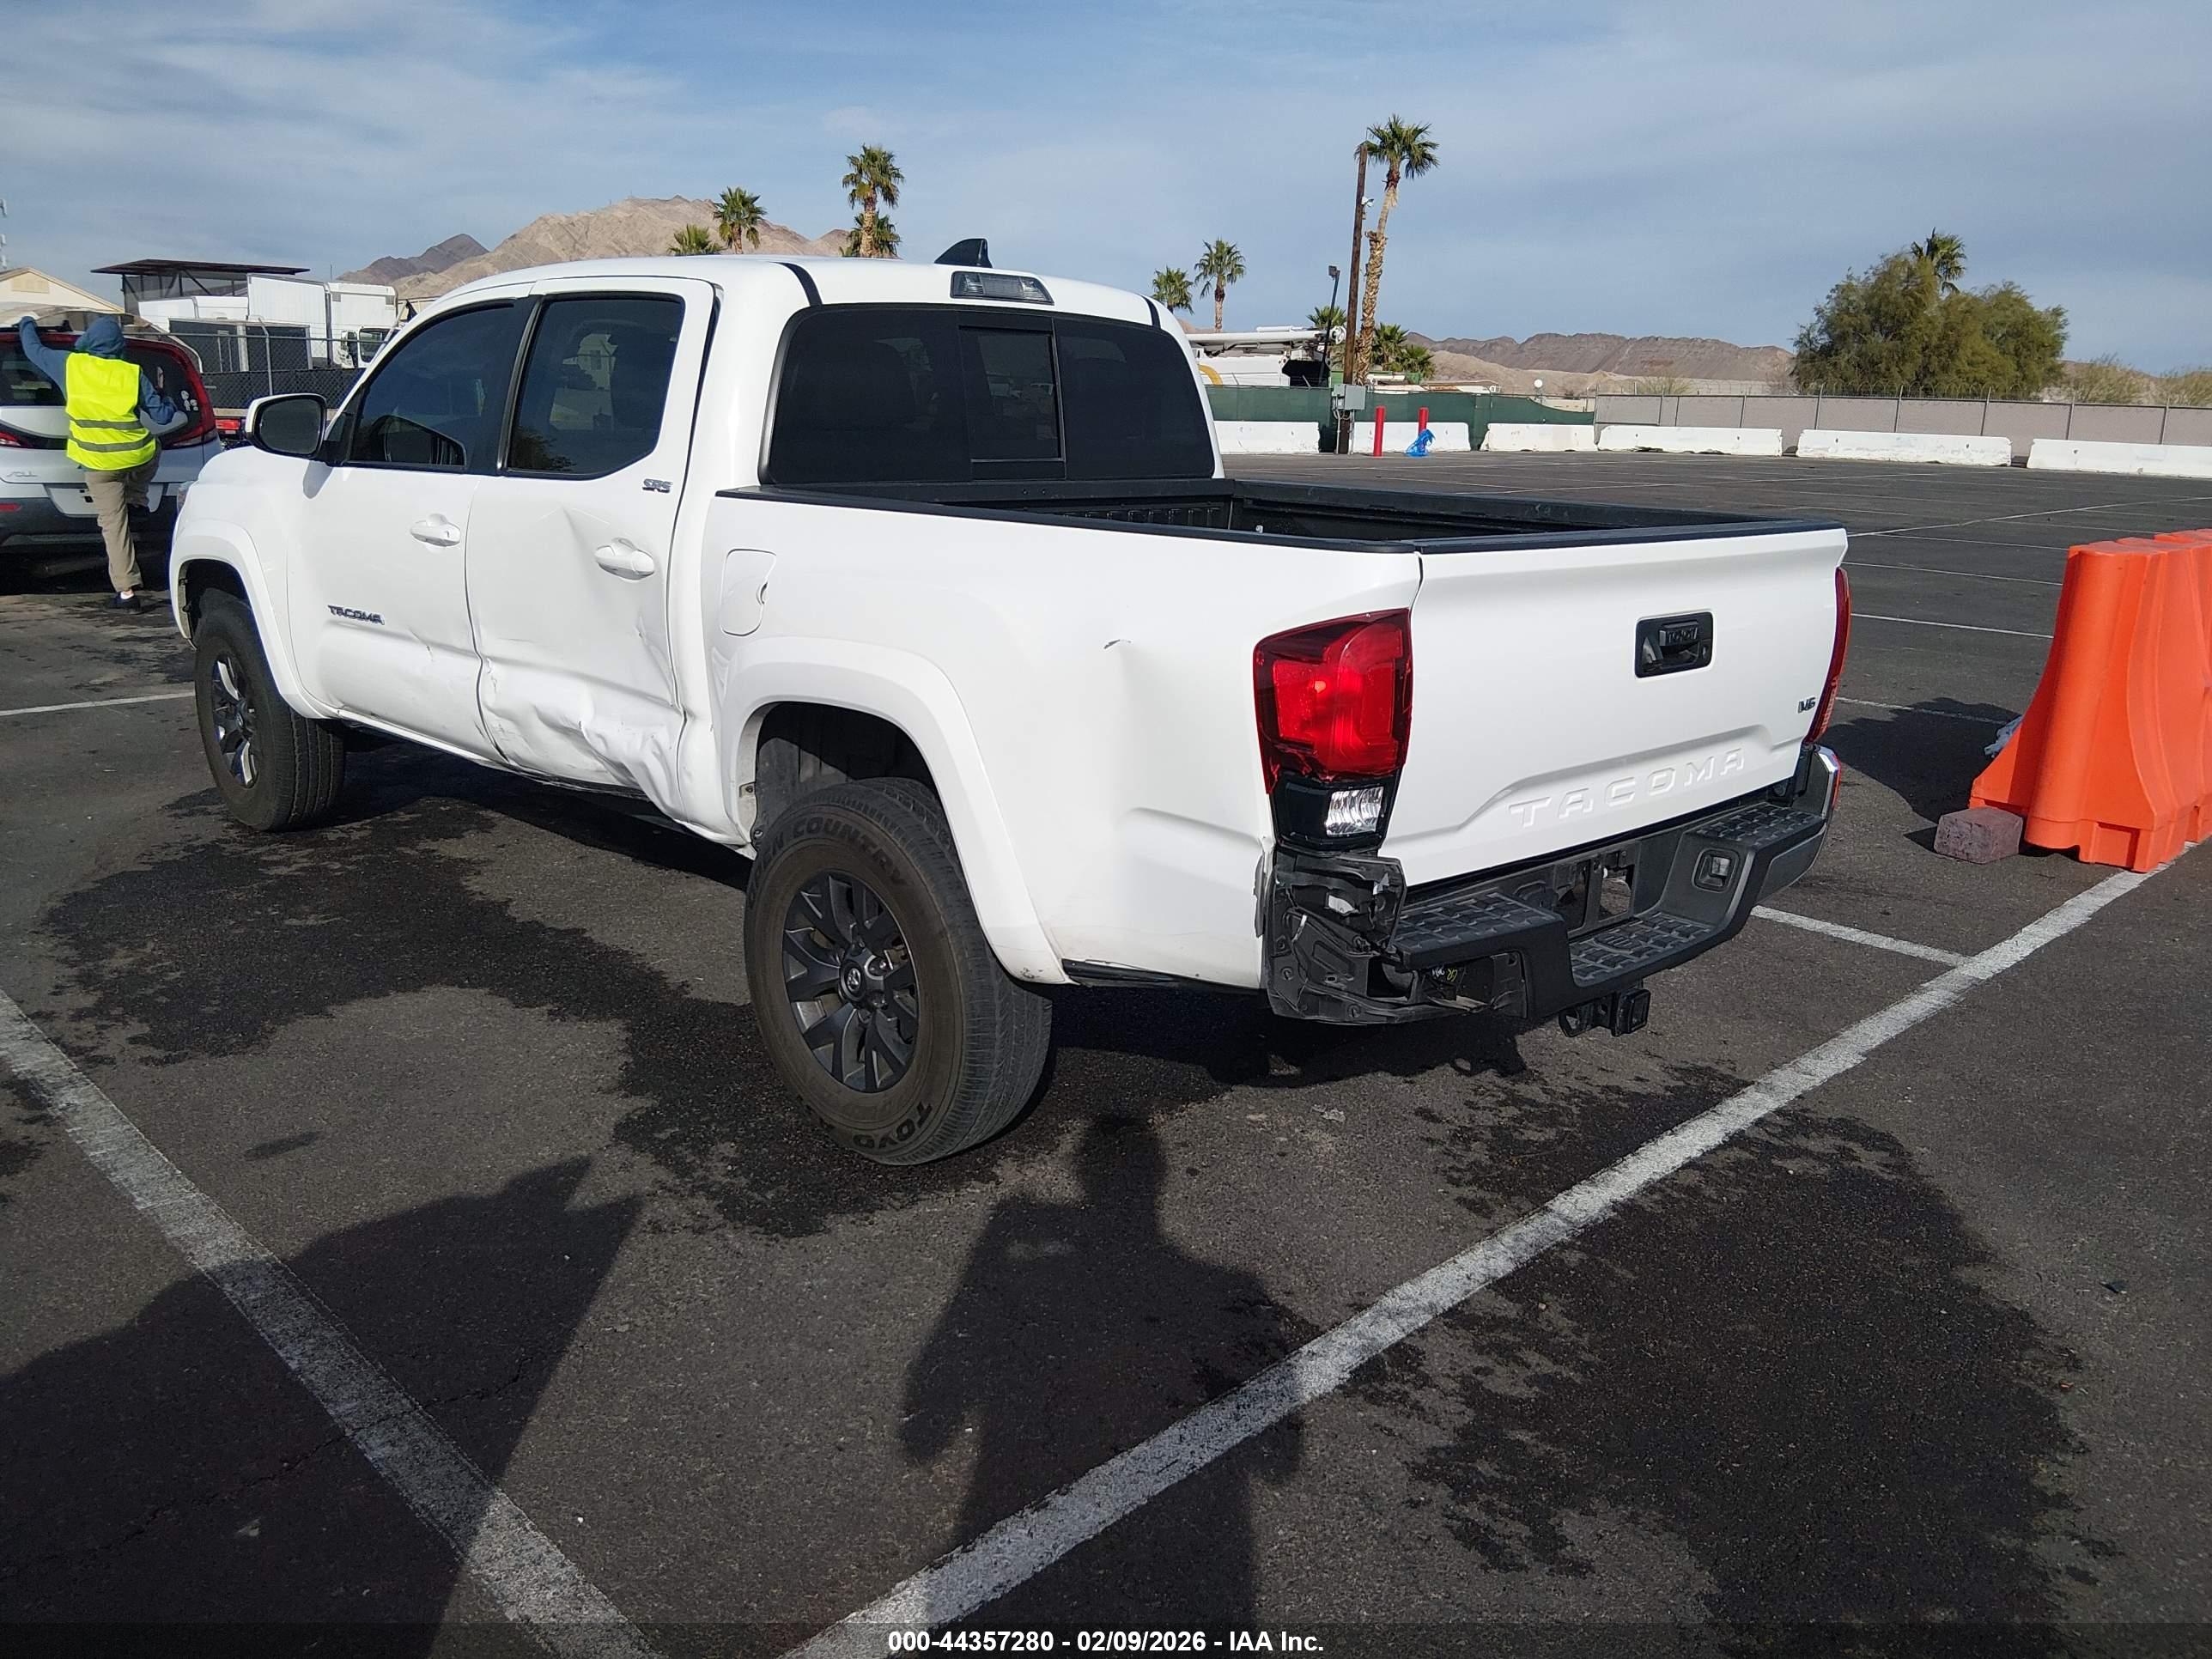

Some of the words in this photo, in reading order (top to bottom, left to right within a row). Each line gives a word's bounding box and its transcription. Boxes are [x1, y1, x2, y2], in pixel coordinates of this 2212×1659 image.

[327, 605, 386, 625] TACOMA
[1509, 747, 1745, 828] TACOMA
[793, 817, 908, 885] COUNTRY
